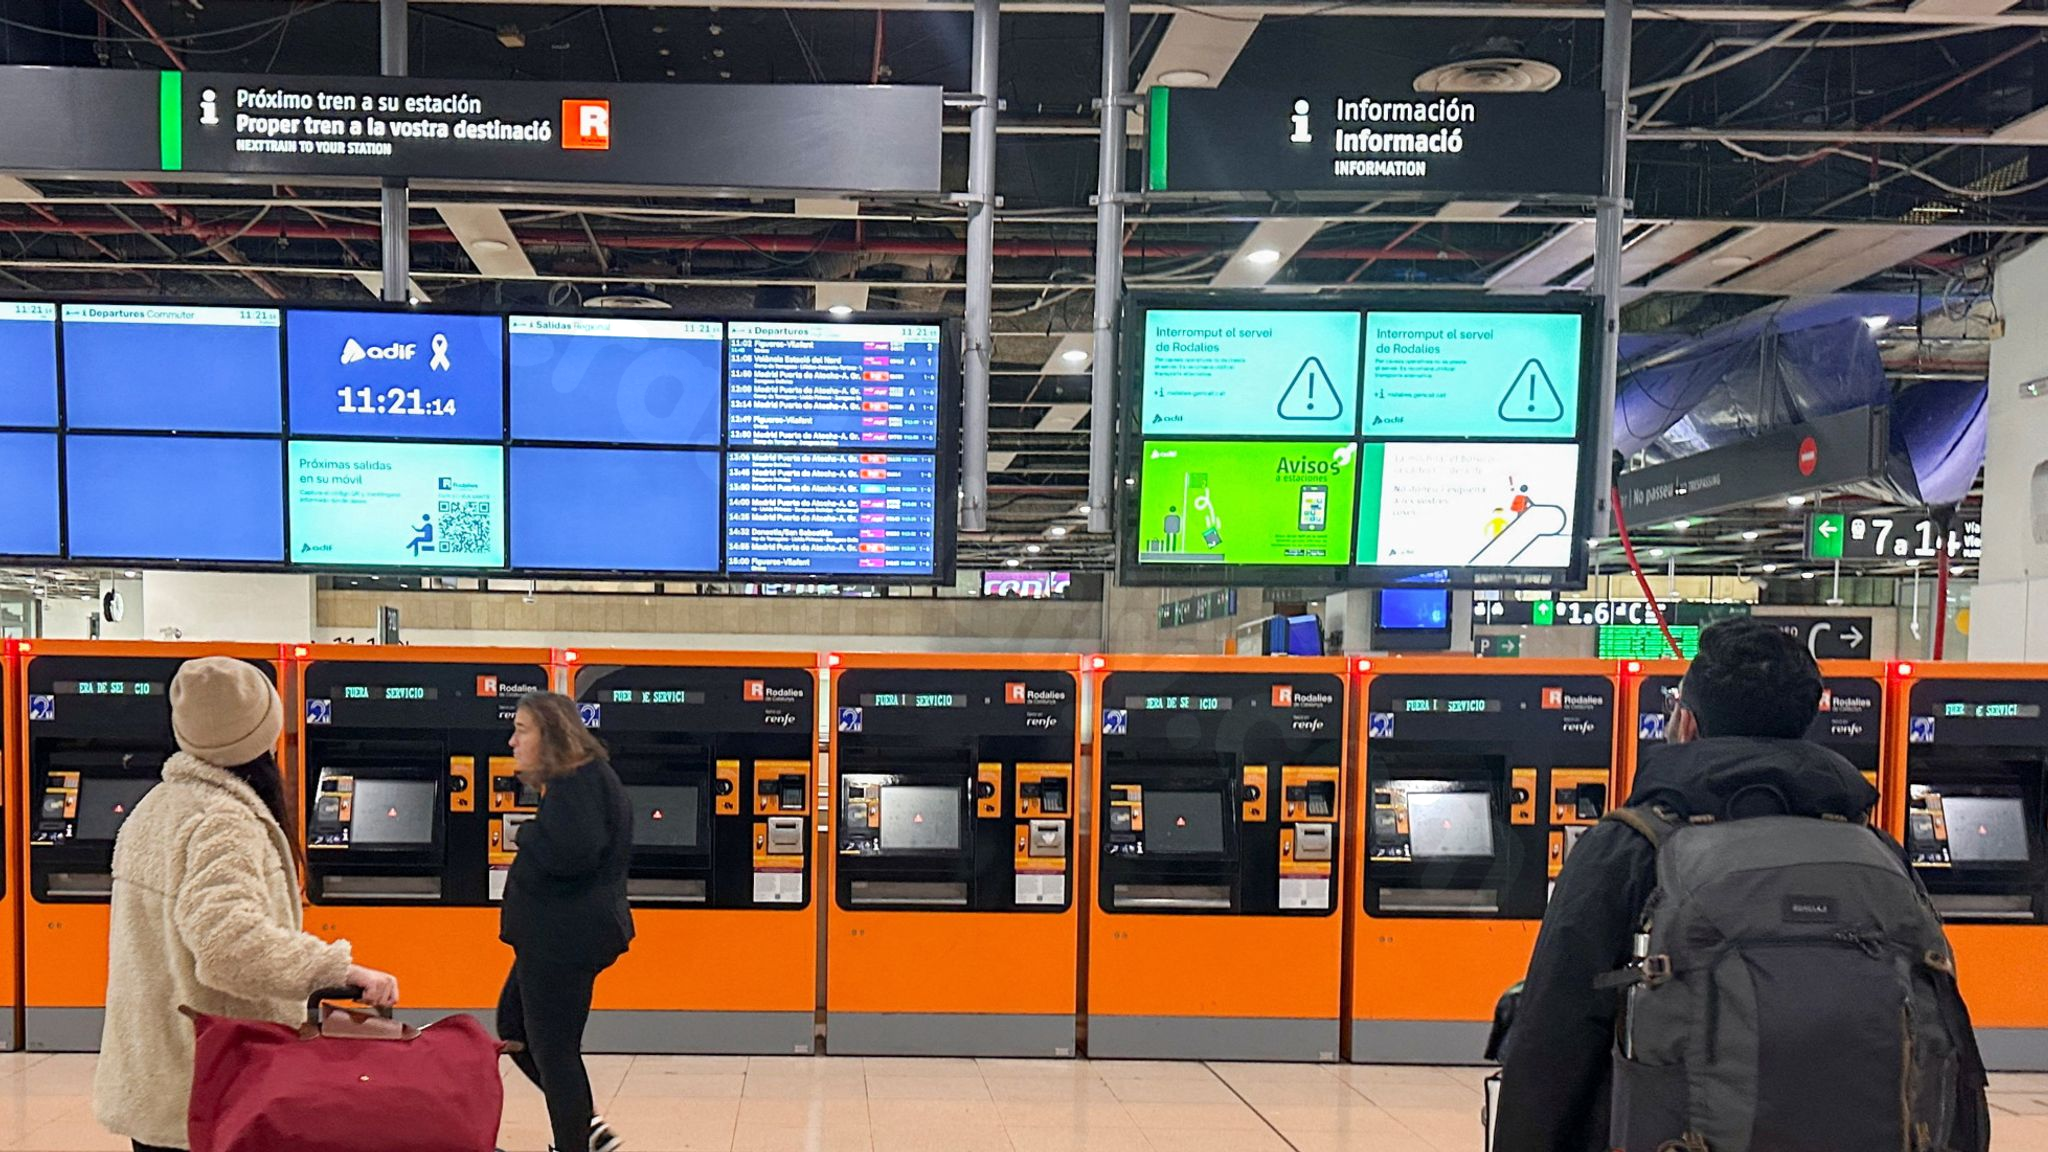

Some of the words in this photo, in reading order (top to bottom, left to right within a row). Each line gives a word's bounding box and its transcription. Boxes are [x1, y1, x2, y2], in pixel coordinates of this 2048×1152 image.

[237, 89, 312, 109] Próximo
[318, 92, 355, 110] tren
[361, 96, 373, 111] a
[378, 96, 399, 112] su
[405, 94, 482, 114] estación
[1337, 98, 1475, 122] Información
[236, 114, 300, 137] Proper
[304, 117, 344, 135] tren
[350, 120, 362, 136] a
[367, 117, 386, 136] la
[390, 120, 449, 138] vostra
[453, 120, 550, 141] destinació
[1335, 128, 1463, 152] Informació
[298, 141, 314, 153] TO
[316, 141, 345, 154] YOUR
[347, 142, 392, 156] STATION
[1334, 160, 1426, 176] INFORMATION
[88, 308, 145, 318] Departures
[536, 320, 571, 330] Salidas
[754, 327, 808, 336] Departures
[1156, 327, 1223, 339] Interromput
[1239, 328, 1272, 338] servei
[1377, 329, 1443, 340] Interromput
[1460, 329, 1493, 340] servei
[366, 342, 416, 360] adif
[1155, 342, 1169, 352] de
[1172, 342, 1219, 352] Rodalies
[1376, 343, 1390, 353] de
[1393, 344, 1440, 354] Rodalies
[299, 458, 351, 469] Próximas
[353, 460, 392, 471] salidas
[1276, 456, 1341, 476] Avisos
[300, 475, 313, 484] en
[317, 475, 329, 484] su
[332, 474, 362, 484] móvil
[1872, 519, 1893, 555] 7
[386, 688, 424, 699] SERVICIO
[499, 684, 537, 693] Rodalies
[765, 688, 803, 697] Rodalies
[916, 695, 952, 707] SERVICIO
[1026, 690, 1065, 700] Rodalies
[1293, 693, 1333, 703] Rodalies
[1564, 695, 1603, 705] Rodalies
[1448, 700, 1485, 712] SERVICIO
[1832, 697, 1871, 708] Rodalies
[765, 713, 795, 726] renfe
[1026, 715, 1057, 729] renfe
[1292, 718, 1324, 732] renfe
[1563, 720, 1594, 734] renfe
